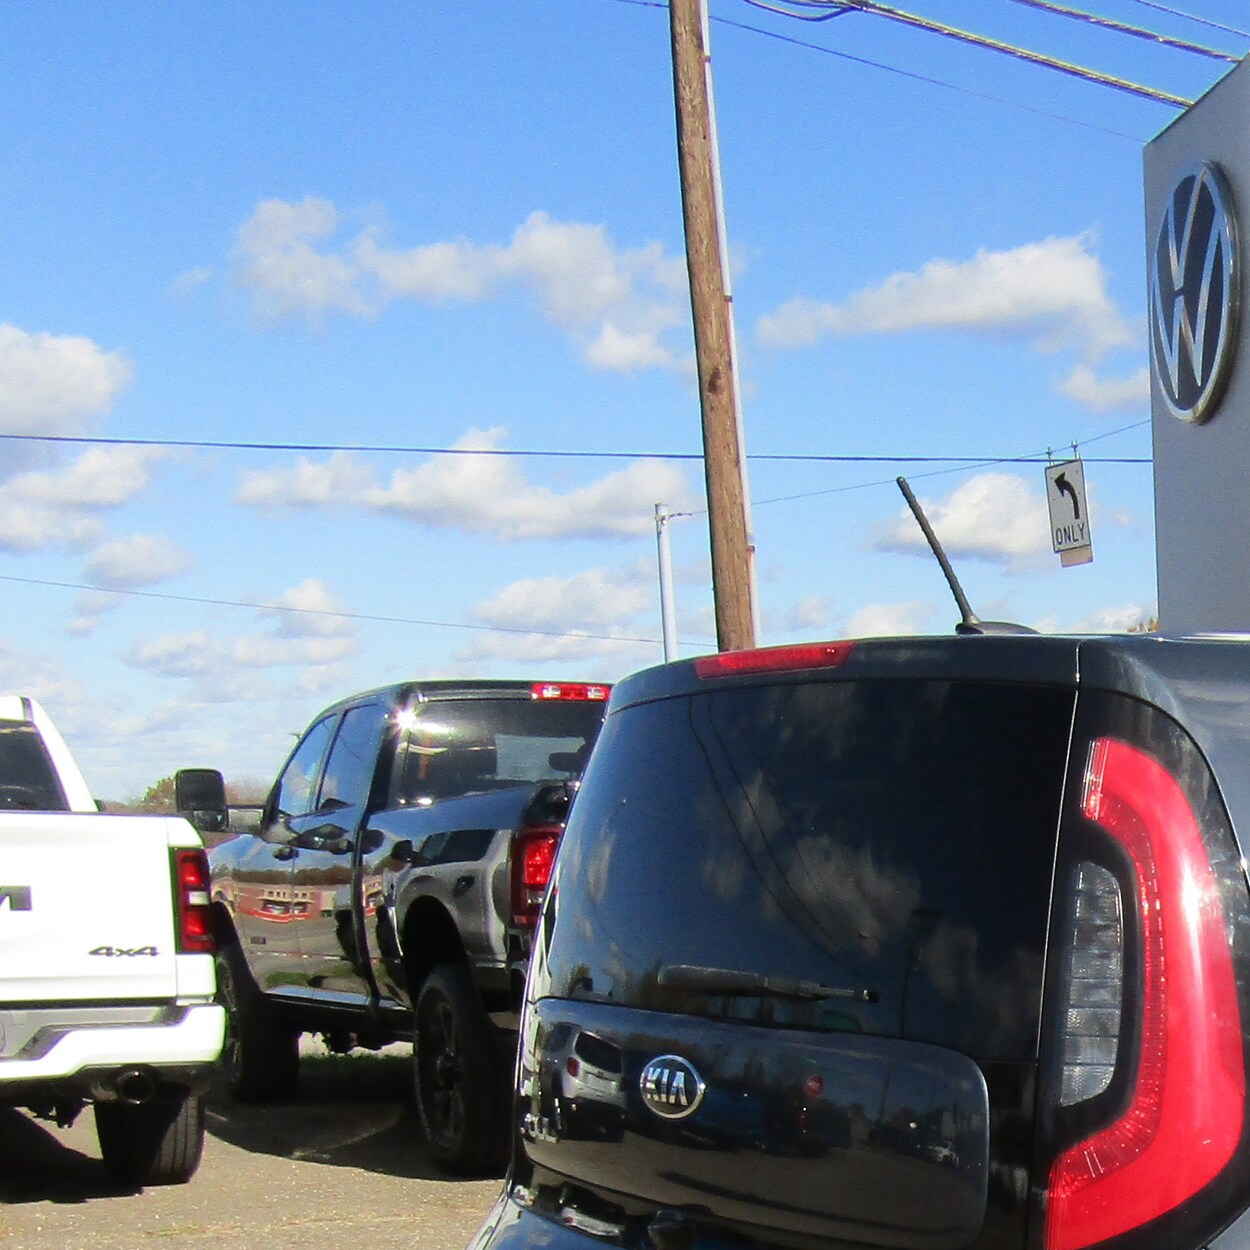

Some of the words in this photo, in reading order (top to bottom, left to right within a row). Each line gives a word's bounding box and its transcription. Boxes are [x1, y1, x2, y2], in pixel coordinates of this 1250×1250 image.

[1055, 523, 1085, 545] ONLY
[88, 946, 159, 957] 4x4
[645, 1067, 689, 1106] KIA
